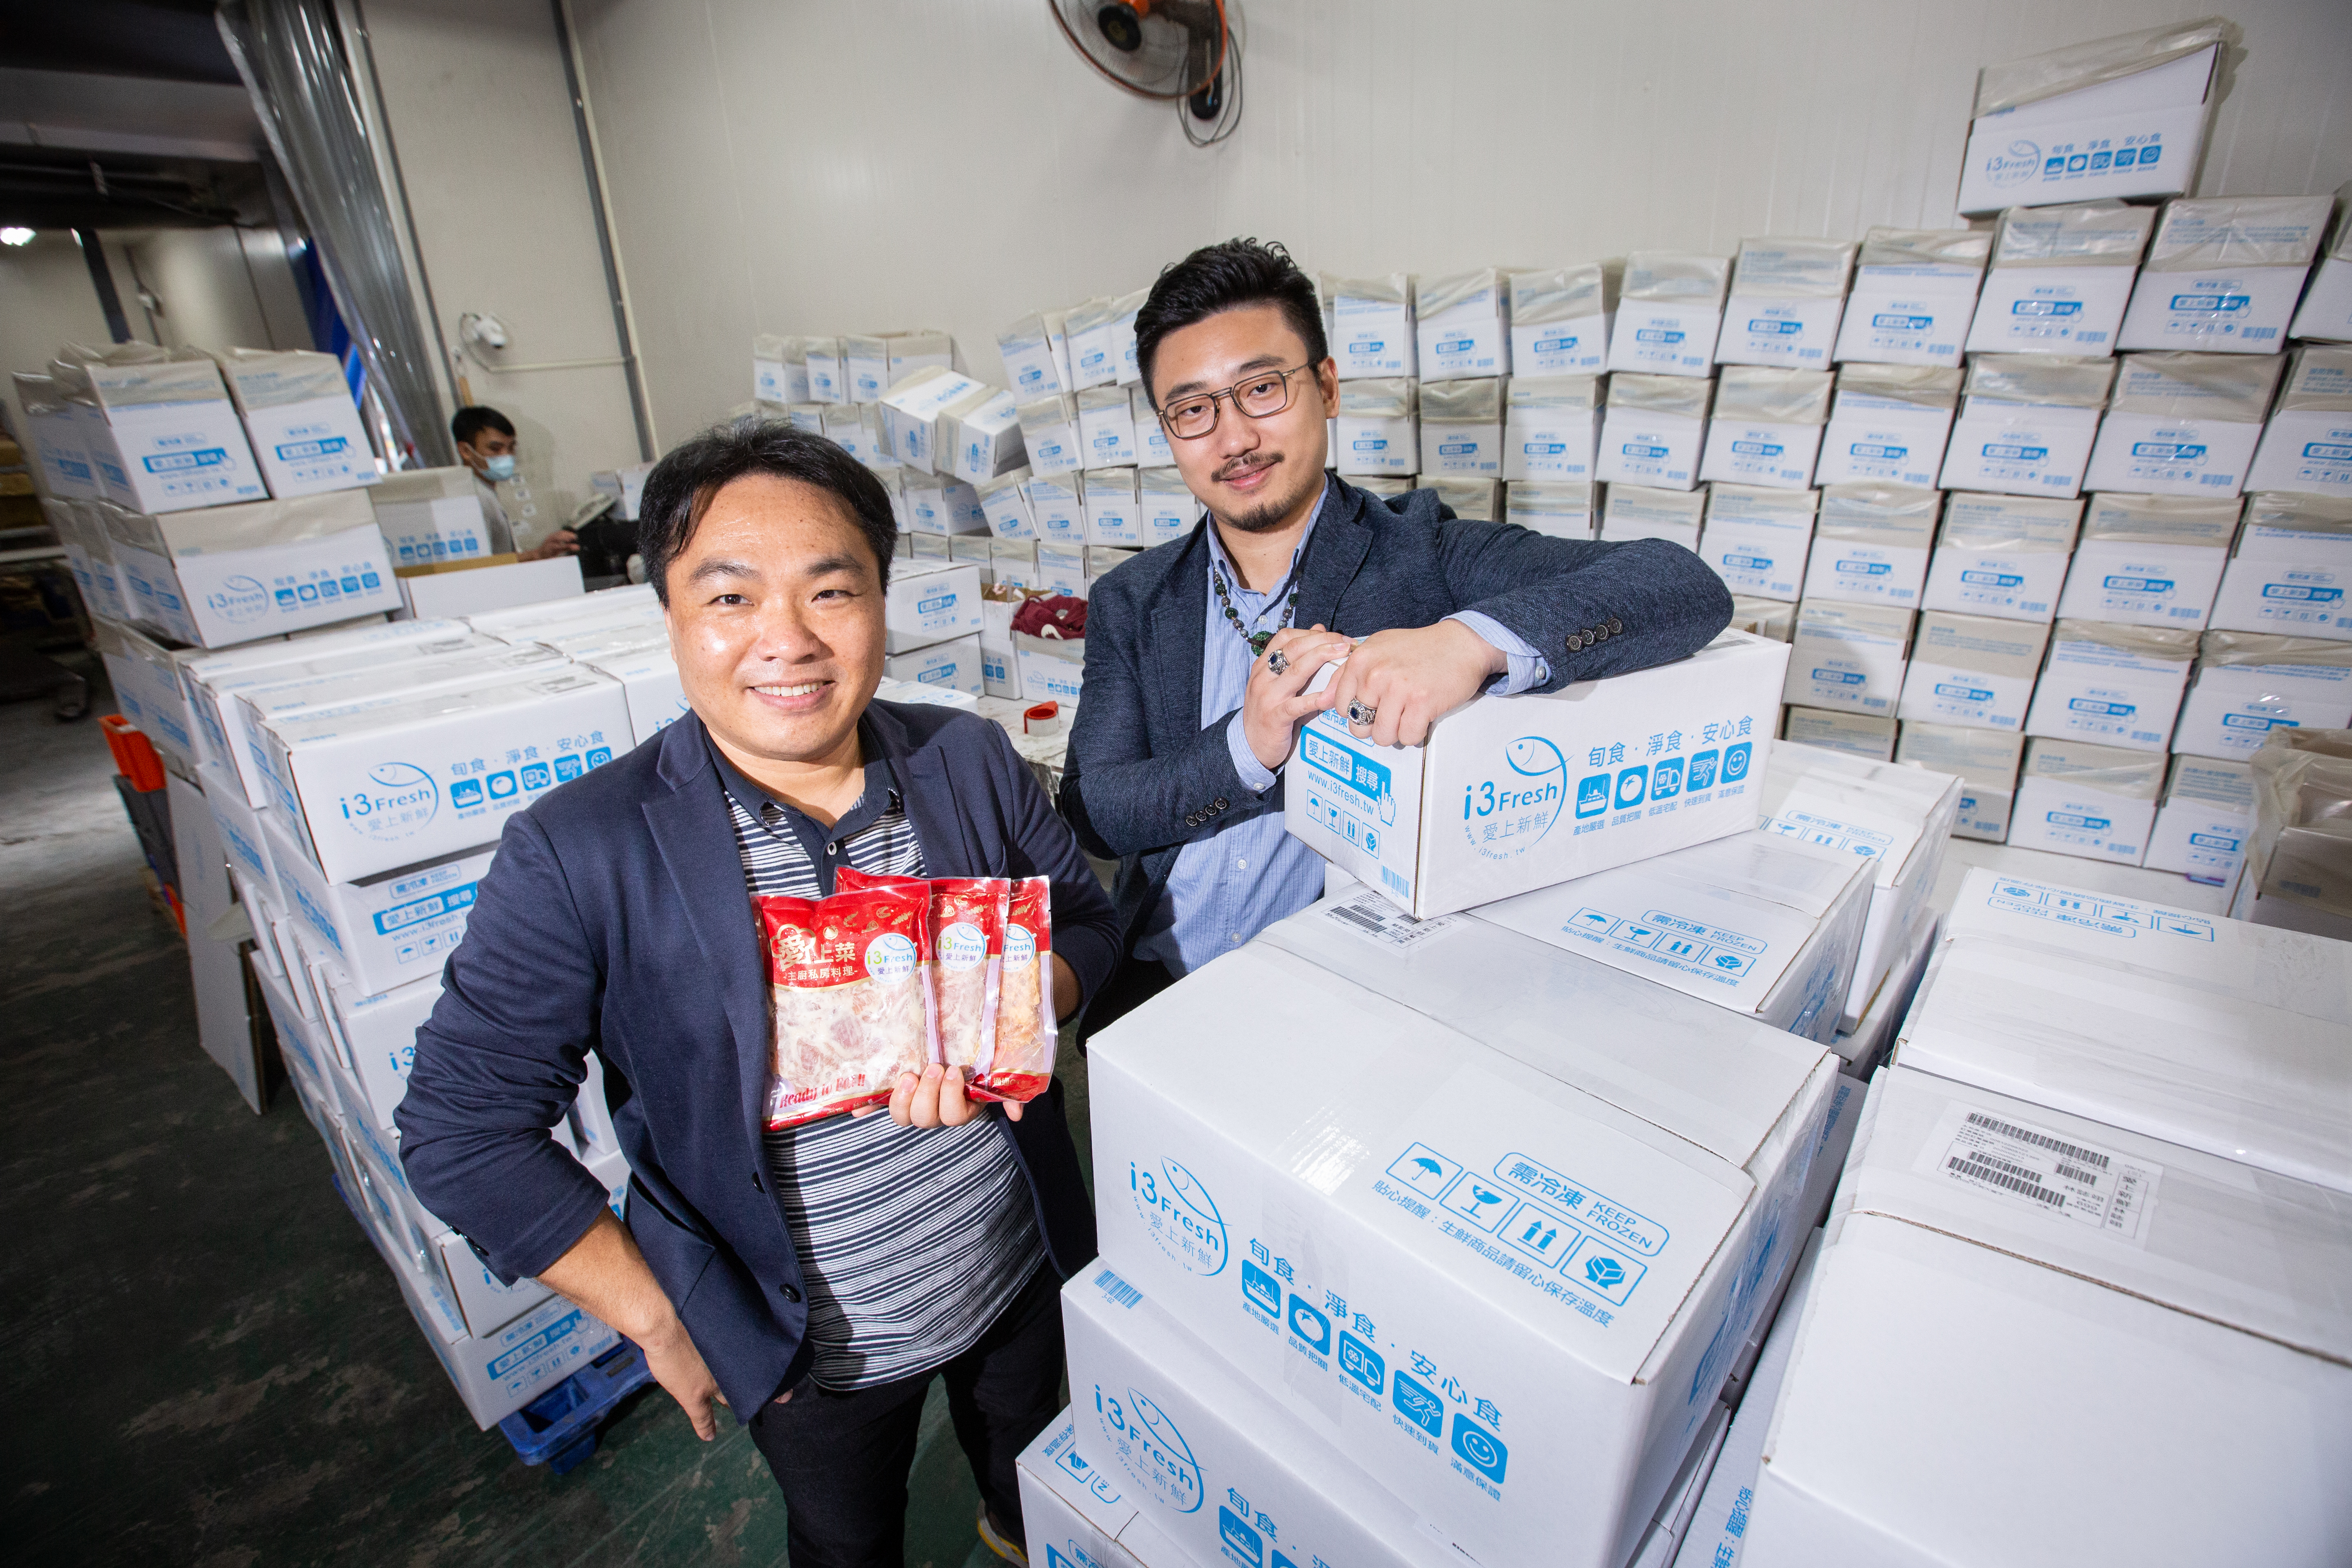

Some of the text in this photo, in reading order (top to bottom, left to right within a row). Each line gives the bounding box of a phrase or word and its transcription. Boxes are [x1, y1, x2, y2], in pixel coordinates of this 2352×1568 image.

[1308, 739, 1378, 792] 愛上新鮮 搜尋
[340, 789, 430, 820] i3Fresh
[1308, 770, 1374, 815] www.i3fresh.tw
[1464, 780, 1557, 820] i3Fresh
[1684, 792, 1711, 808] 快速到貨
[1717, 785, 1745, 800] 滿意保證
[367, 807, 429, 832] 愛上新鮮
[1611, 811, 1642, 826] 品質把關
[1648, 801, 1677, 817] 低溫宅配
[1483, 811, 1549, 843] 愛上新鮮
[1573, 819, 1605, 836] 產地嚴選
[1651, 914, 1708, 936] 需冷凍
[1713, 930, 1744, 941] KEEP
[777, 933, 856, 972] 愛上菜
[867, 951, 913, 965] i3Fresh
[938, 936, 981, 952] i3Fresh
[945, 953, 976, 962] 愛上新鮮
[1710, 935, 1757, 951] FROZEN
[878, 964, 909, 975] 愛上新鮮
[779, 1087, 817, 1108] Ready
[1508, 1161, 1586, 1210] 需冷凍
[1131, 1161, 1218, 1251] i3Fresh
[1593, 1201, 1637, 1225] KEEP
[1150, 1212, 1212, 1269] 愛上新鮮
[1586, 1210, 1653, 1249] FROZEN
[1371, 1180, 1614, 1328] 貼心提醒：生鮮商品請留心保存溫度
[1101, 1293, 1115, 1305] 3-02
[1243, 1301, 1279, 1335] 產地嚴選
[1288, 1336, 1328, 1372] 品質把關
[1339, 1373, 1381, 1412] 低溫宅配
[1095, 1384, 1193, 1491] i3Fresh
[1392, 1414, 1439, 1456] 快速到貨
[1117, 1437, 1187, 1506] 愛上新鮮
[1450, 1457, 1501, 1502] 滿意保證
